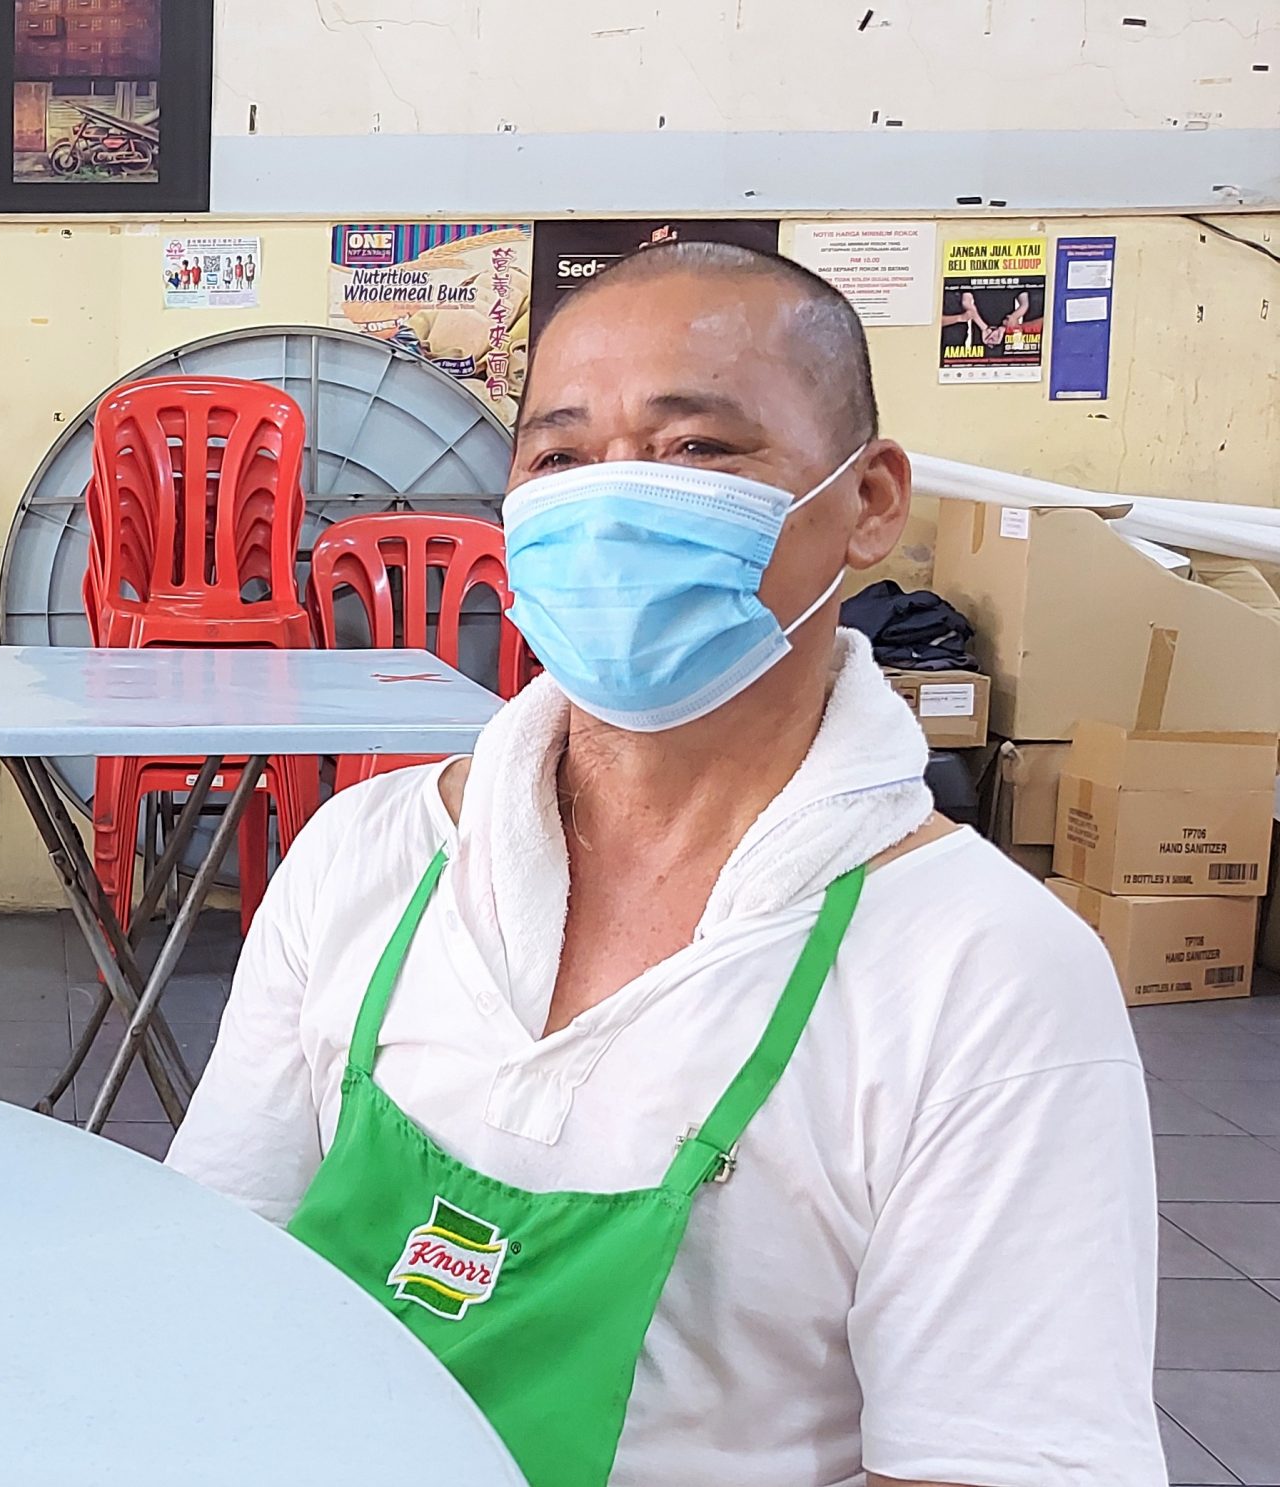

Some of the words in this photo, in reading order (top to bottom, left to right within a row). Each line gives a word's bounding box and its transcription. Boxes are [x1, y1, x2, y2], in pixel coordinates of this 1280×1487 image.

[349, 233, 392, 249] ONE
[949, 246, 987, 257] JANGAN
[989, 246, 1012, 257] JUAL
[1015, 245, 1040, 256] ATAU
[948, 260, 967, 271] BELI
[970, 259, 1000, 270] ROKOK
[1002, 259, 1041, 269] SELUDUP
[353, 269, 429, 285] Nutritious
[344, 285, 433, 301] Wholemeal
[437, 286, 477, 301] Buns
[944, 346, 984, 358] AMARAN
[1182, 828, 1207, 839] TP706
[1159, 843, 1183, 854] HAND
[1184, 843, 1228, 854] SANITIZER
[1123, 875, 1131, 884] 12
[1132, 875, 1164, 884] BOTTLES
[1165, 952, 1185, 963] HAND
[1186, 949, 1221, 961] SANITIZER
[408, 1241, 492, 1285] Knorr
